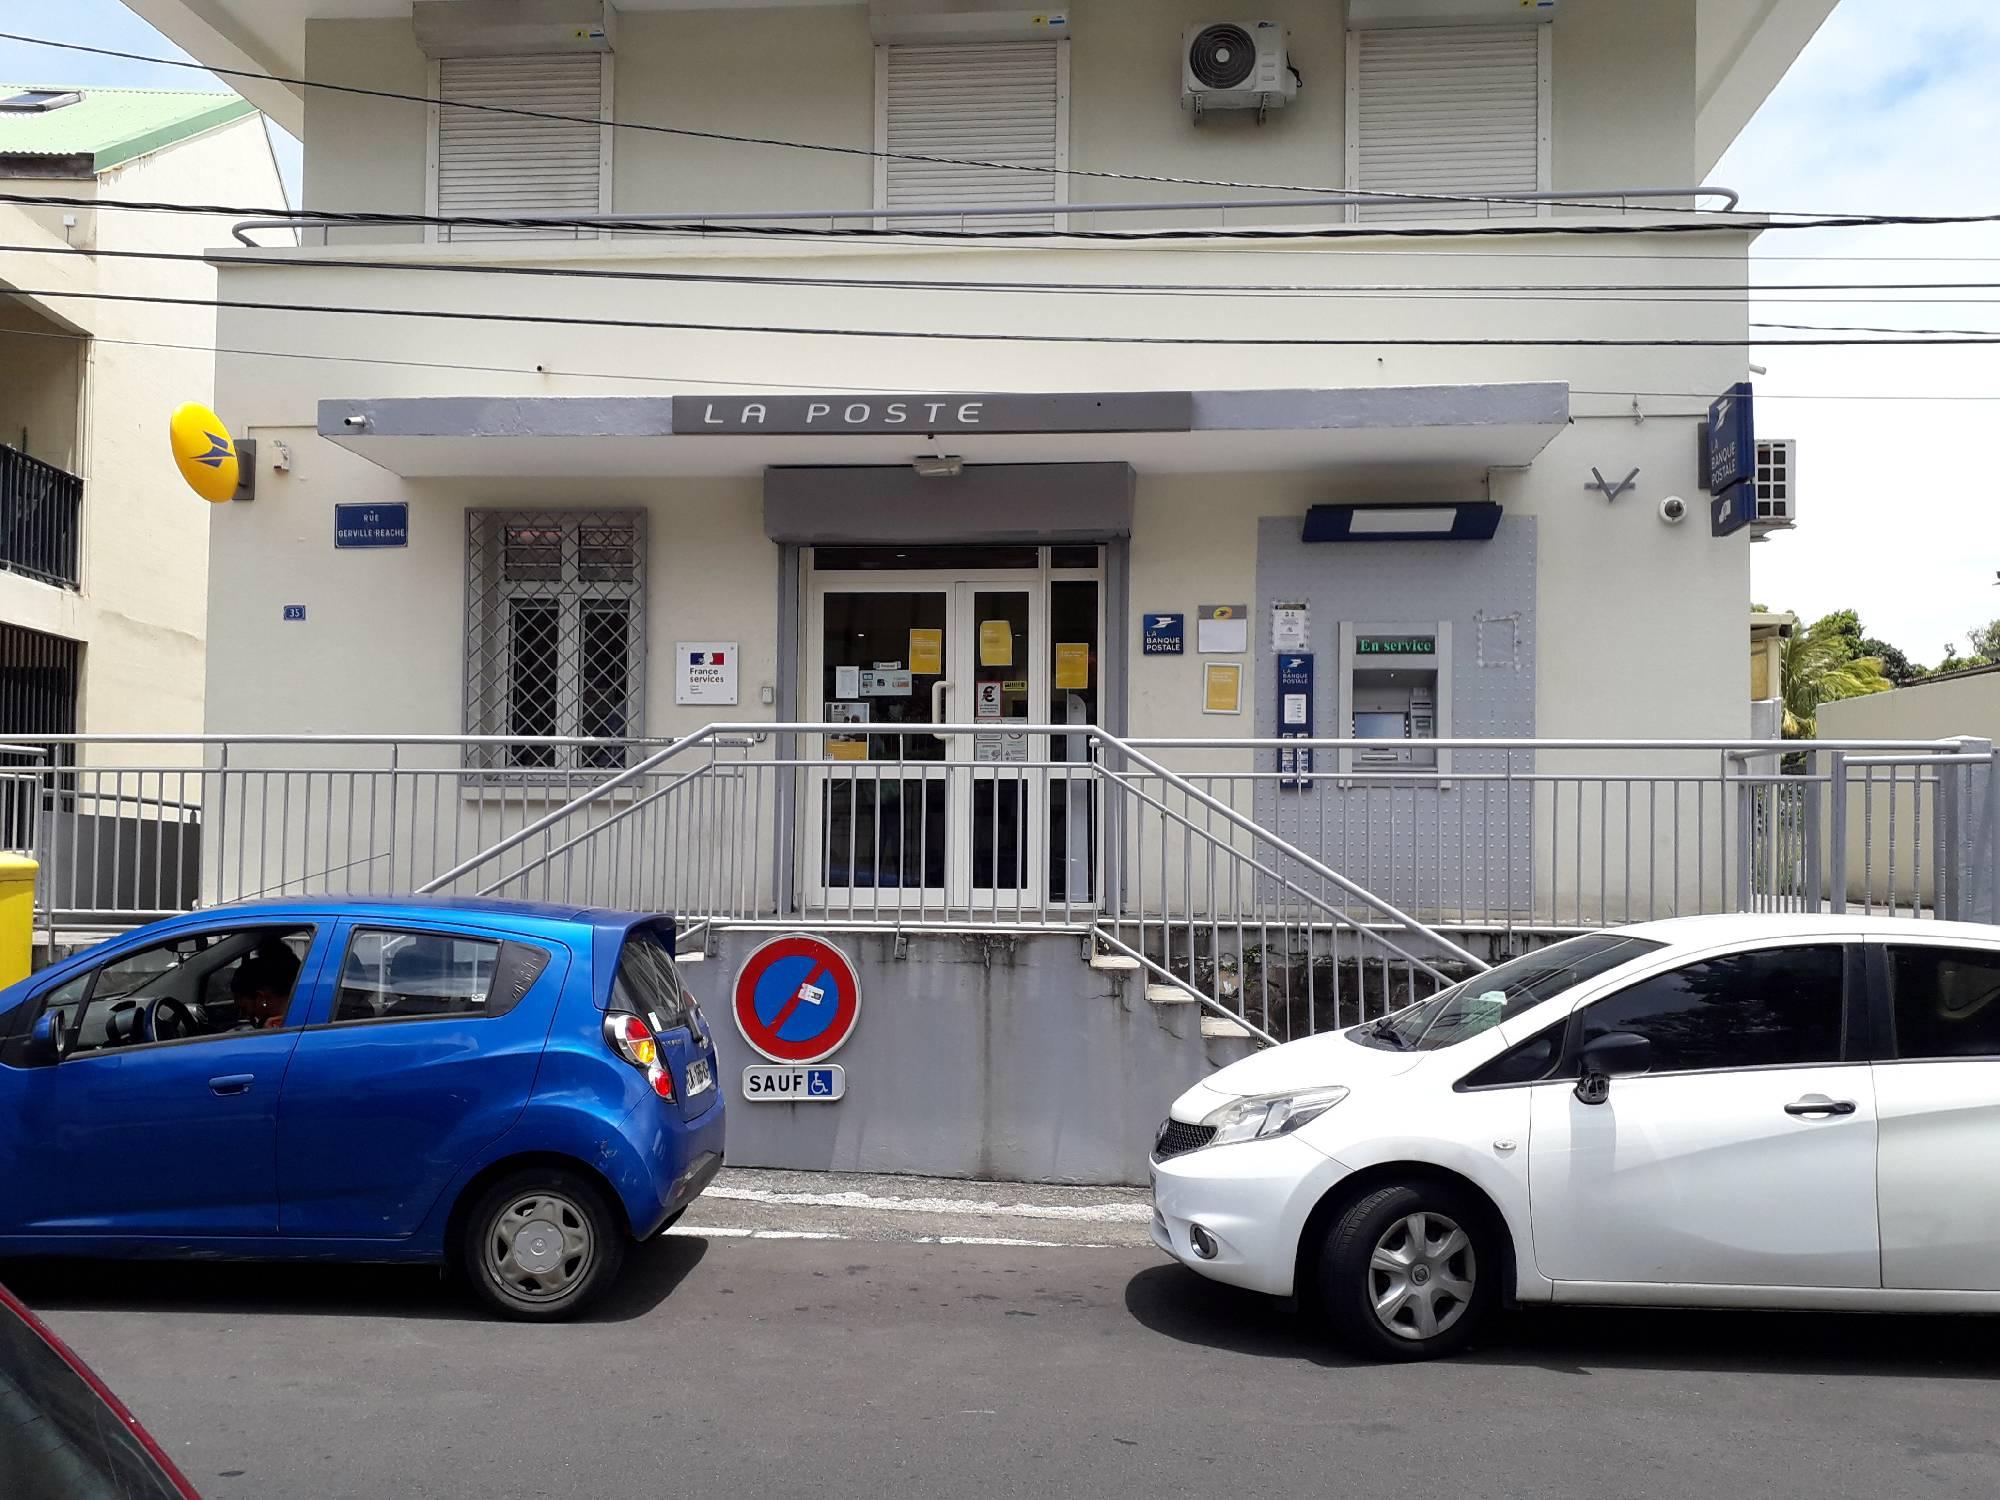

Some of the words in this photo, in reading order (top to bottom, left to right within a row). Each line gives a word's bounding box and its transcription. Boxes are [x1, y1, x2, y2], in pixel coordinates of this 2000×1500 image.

[704, 403, 767, 424] LA
[806, 403, 984, 424] POSTE
[1711, 439, 1719, 454] LA
[1711, 441, 1736, 470] BANQUE
[1711, 460, 1736, 487] POSTALE
[363, 514, 380, 522] RUE
[289, 608, 300, 618] 35
[1360, 639, 1379, 652] En
[1384, 639, 1431, 652] service
[690, 675, 724, 683] services
[749, 1074, 803, 1093] SAUF
